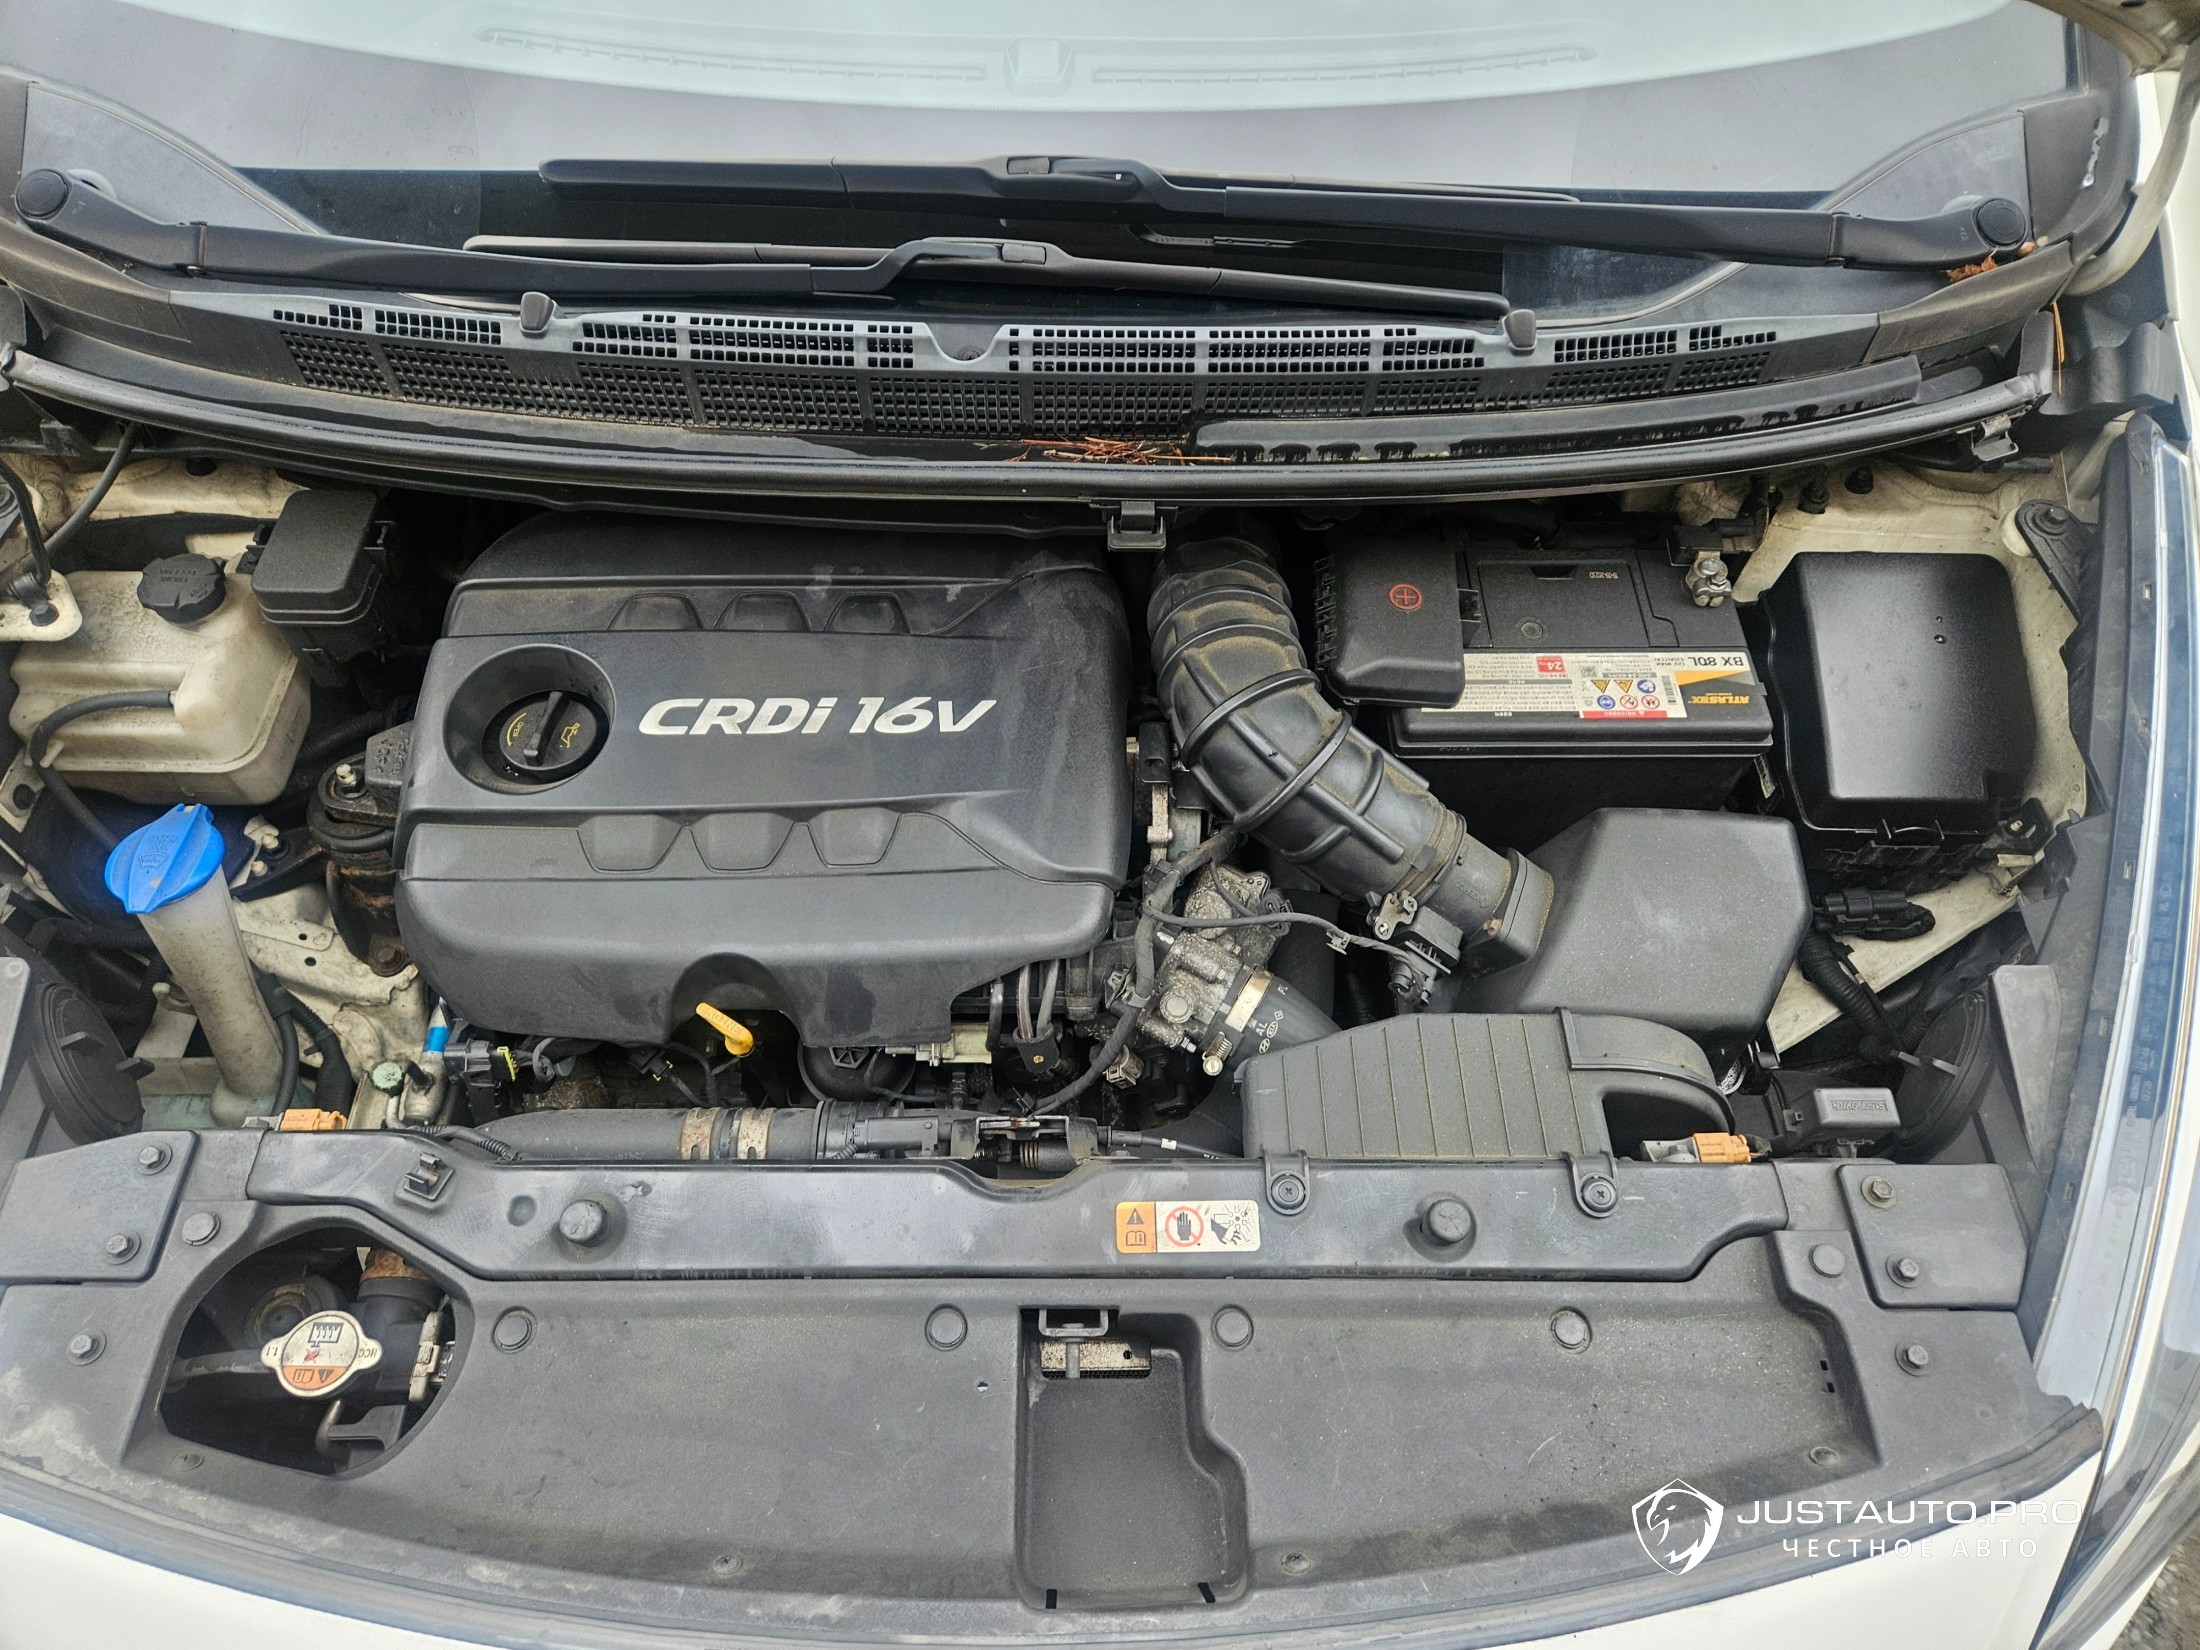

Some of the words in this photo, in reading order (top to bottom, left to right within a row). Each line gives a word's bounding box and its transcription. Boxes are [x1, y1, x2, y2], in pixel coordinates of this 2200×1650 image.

[1547, 660, 1563, 671] 24
[1687, 655, 1717, 667] 80L
[1719, 655, 1744, 667] BX
[1690, 695, 1750, 705] ATLASBX
[638, 697, 838, 735] CRDi
[848, 696, 998, 734] 16V
[512, 721, 525, 738] OPEN
[1836, 1100, 1887, 1111] DIAGNOSIS
[265, 1346, 279, 1357] 1.1
